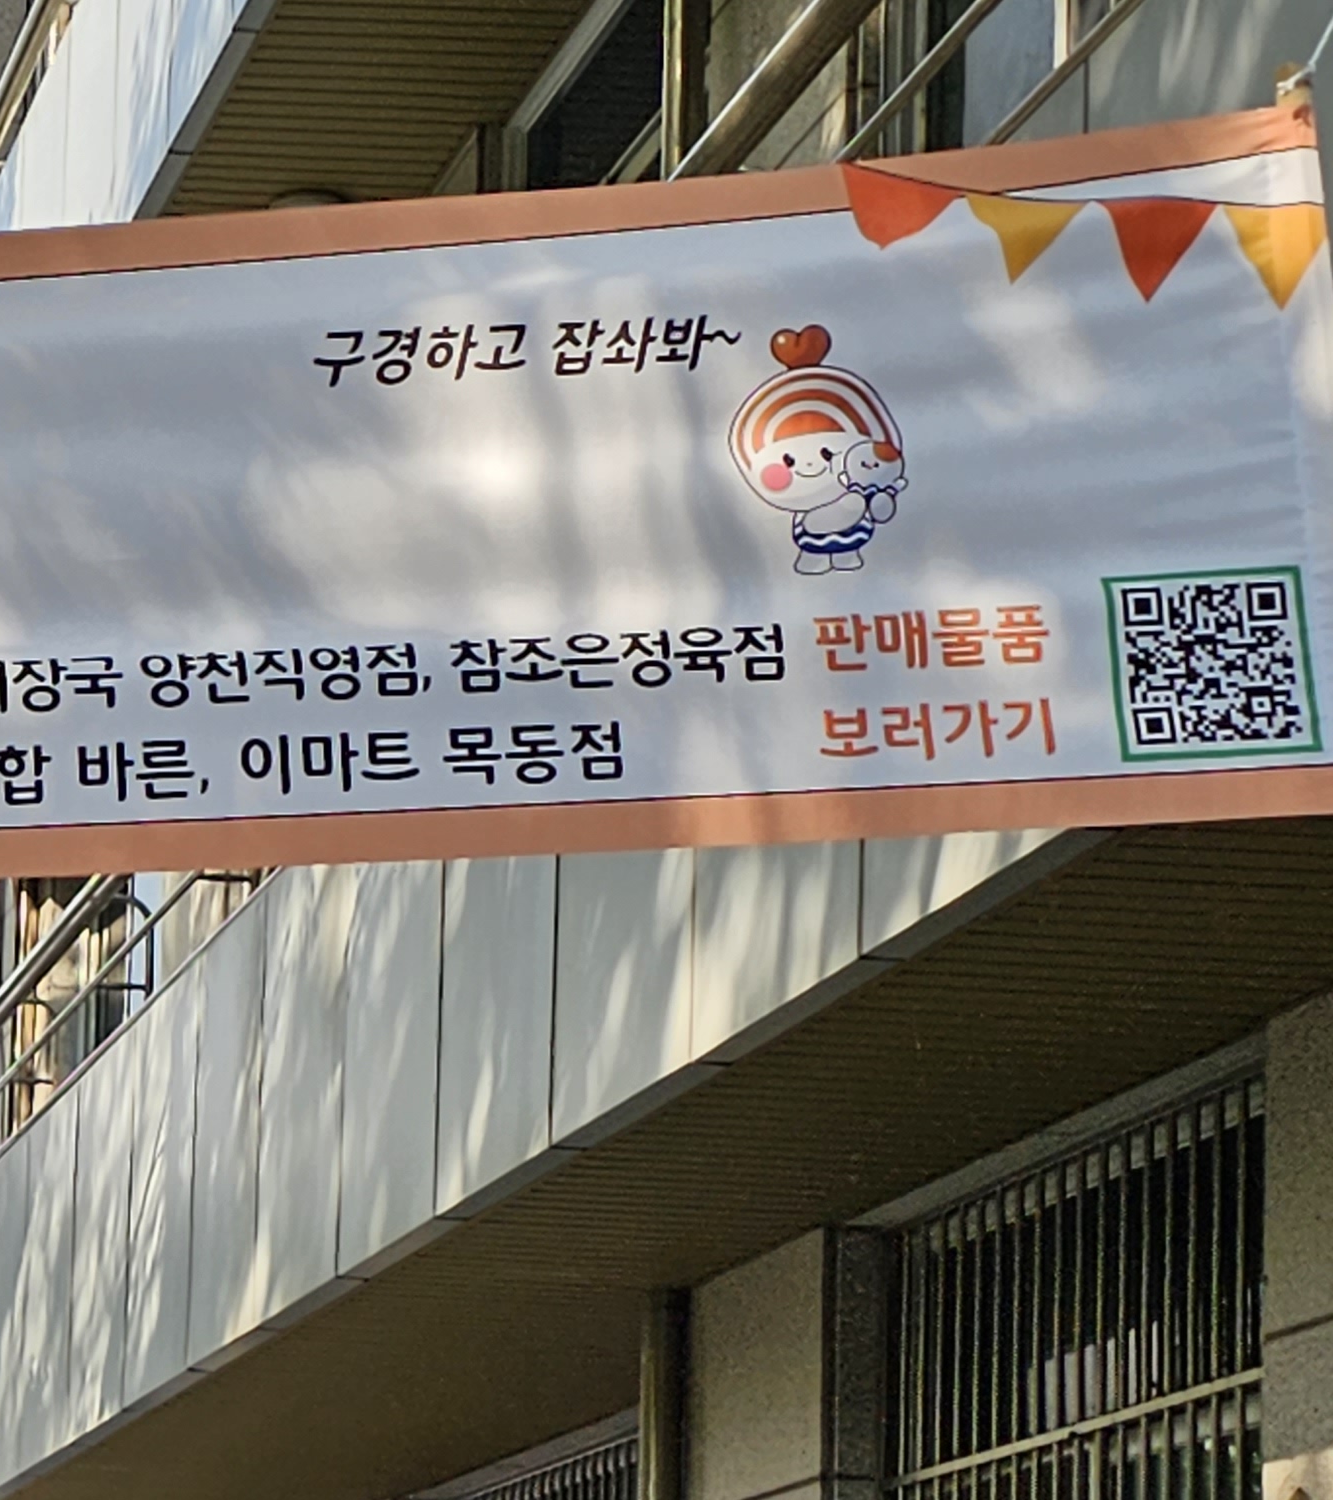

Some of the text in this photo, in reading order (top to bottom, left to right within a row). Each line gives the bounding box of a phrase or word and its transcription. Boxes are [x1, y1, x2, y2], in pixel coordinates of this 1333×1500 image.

[312, 314, 743, 388] 구경하고 잡솨봐~
[138, 642, 432, 708] 양천직영점,
[449, 623, 786, 694] 참조은정육점
[813, 604, 1049, 672] 판매물품
[77, 739, 210, 802] 바른,
[240, 731, 421, 795] 이마트
[442, 721, 625, 785] 목동점
[819, 697, 1056, 760] 보러가기
